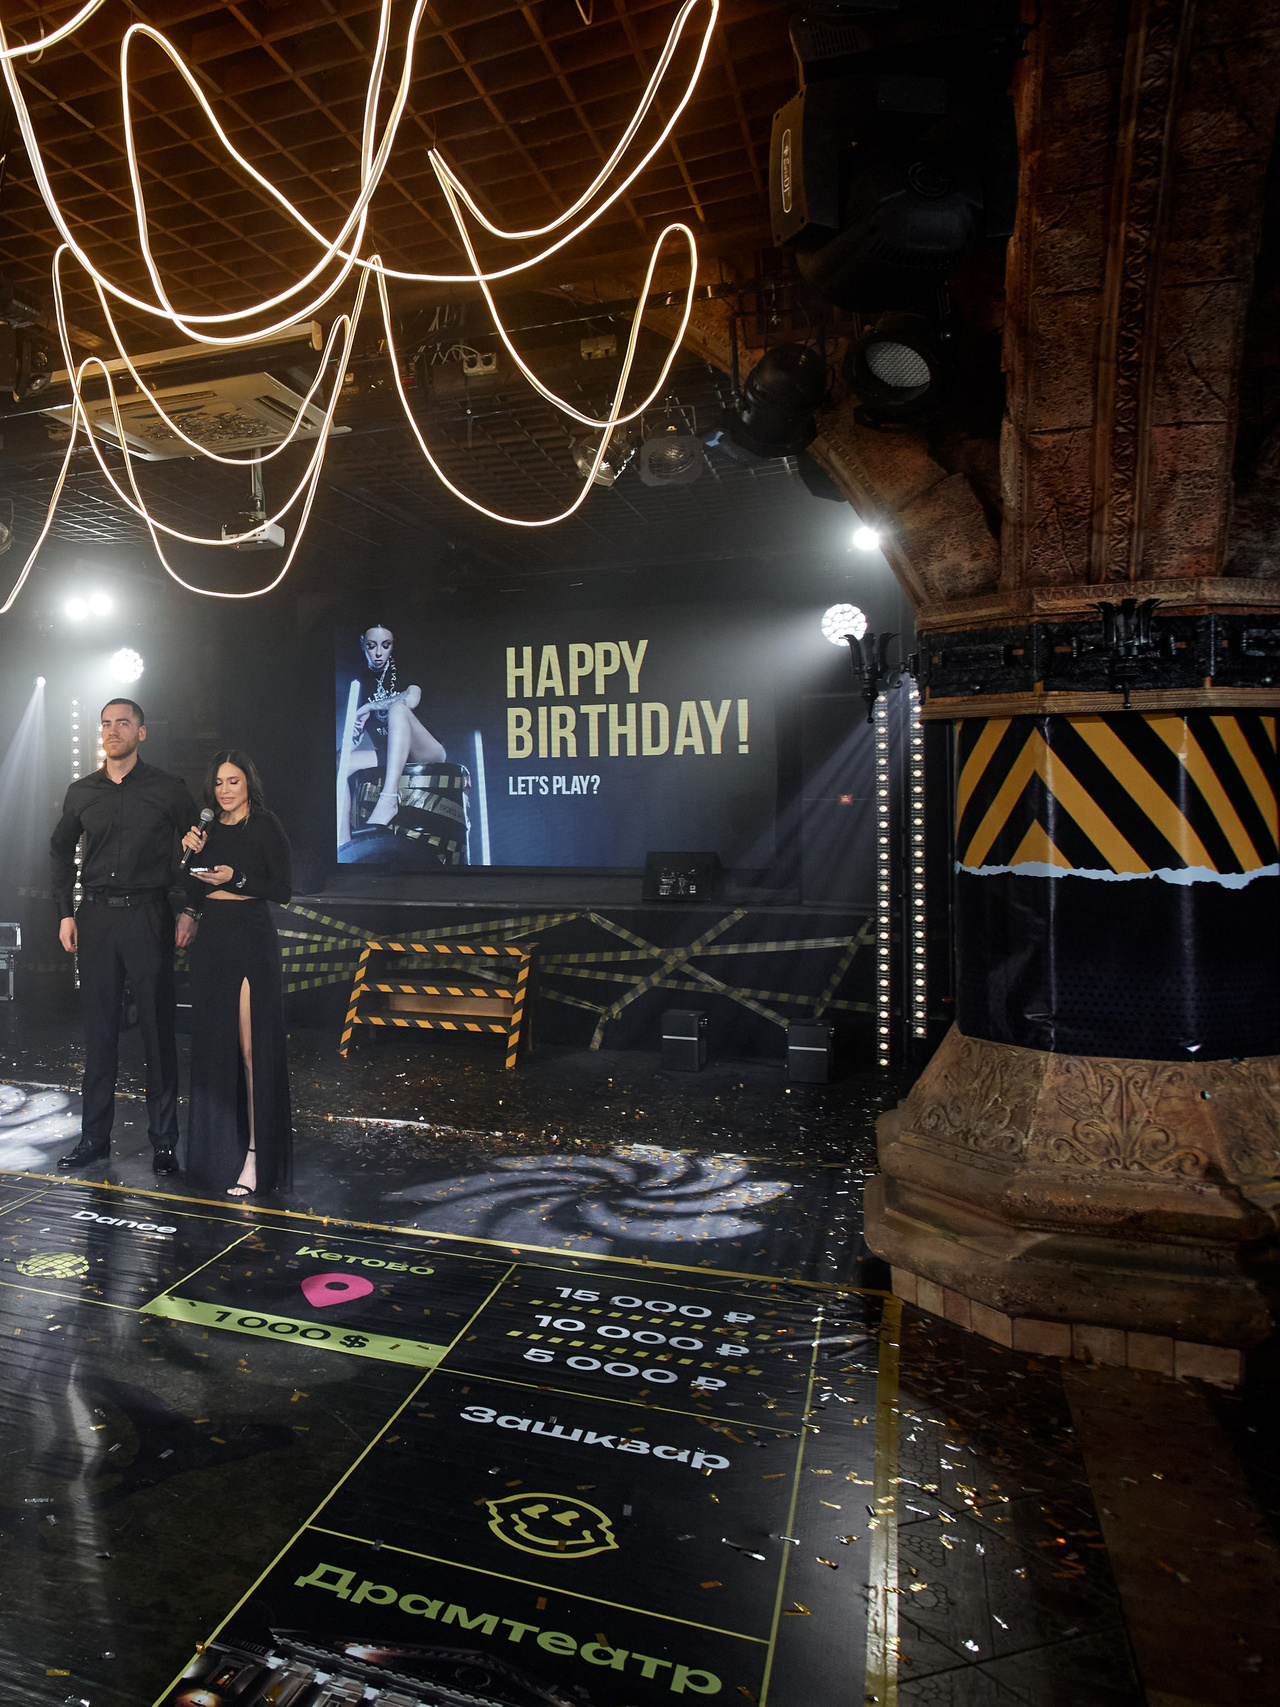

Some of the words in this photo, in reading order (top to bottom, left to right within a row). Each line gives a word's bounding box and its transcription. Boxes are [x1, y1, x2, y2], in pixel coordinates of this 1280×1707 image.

[506, 639, 649, 699] HAPPY
[507, 698, 750, 759] BIRTHDAY!
[508, 775, 550, 796] LET'S
[552, 774, 601, 796] PLAY?
[70, 1210, 177, 1234] Dance
[295, 1245, 435, 1276] Кетово
[555, 1286, 601, 1302] 15
[609, 1295, 713, 1319] 000
[534, 1314, 587, 1332] 10
[596, 1325, 705, 1351] 000
[523, 1347, 556, 1364] 5
[566, 1355, 679, 1384] 000
[459, 1405, 731, 1470] Зашквар
[293, 1562, 722, 1695] Драмтеатр
